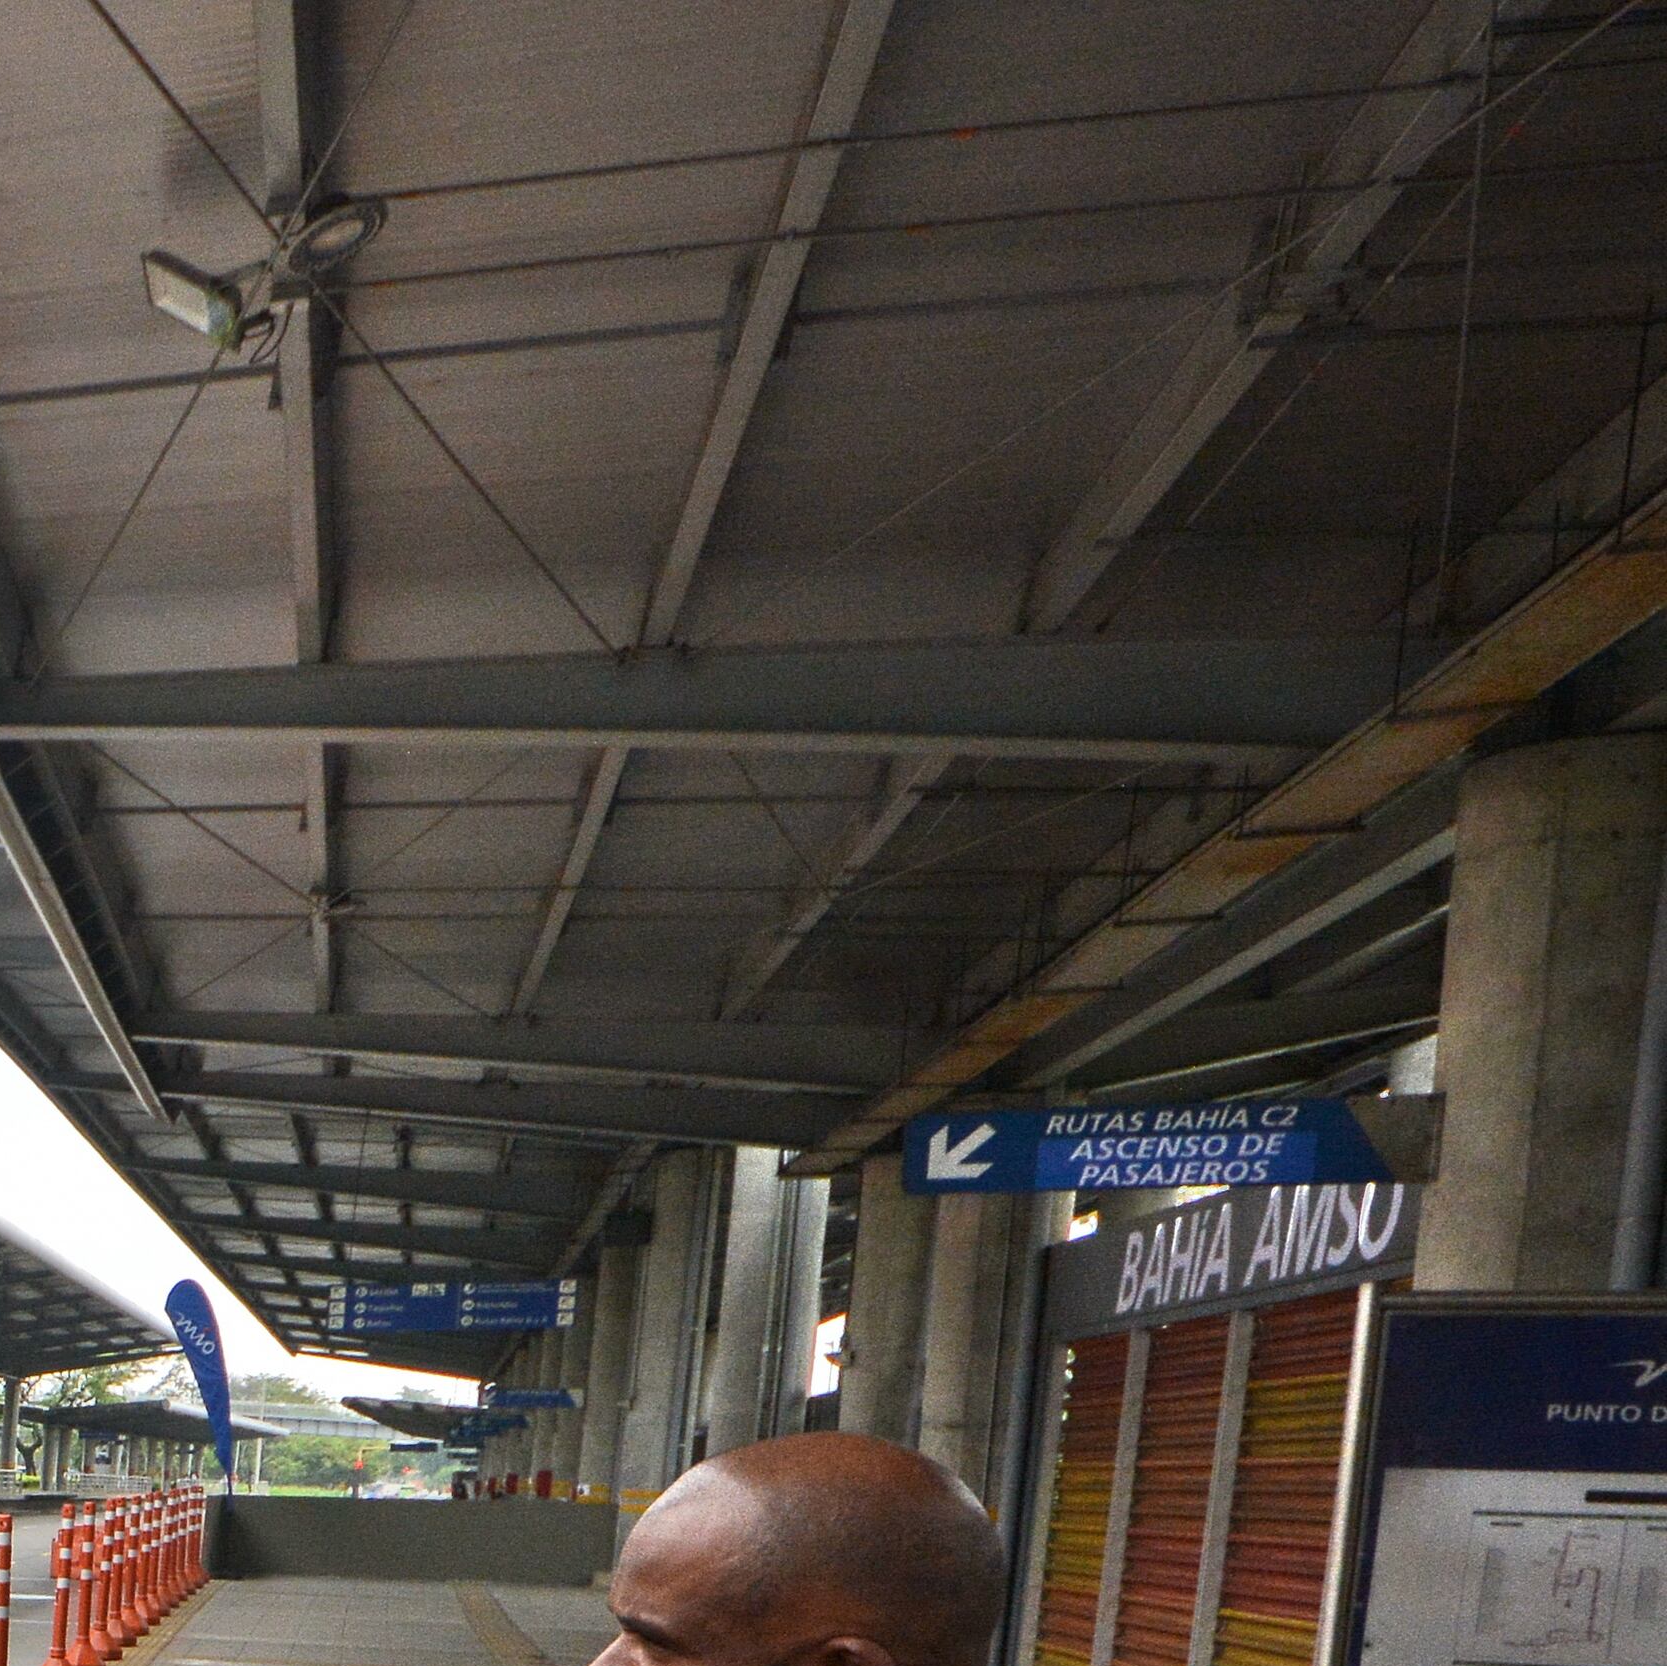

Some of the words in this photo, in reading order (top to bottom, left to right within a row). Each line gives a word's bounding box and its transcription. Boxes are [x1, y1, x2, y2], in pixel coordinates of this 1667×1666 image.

[1046, 1111, 1145, 1135] RUTAS
[1153, 1104, 1249, 1131] BAHÍA
[1261, 1106, 1299, 1128] C2
[1069, 1134, 1228, 1162] ASCENSO
[1238, 1133, 1286, 1156] DE
[1078, 1160, 1270, 1187] PASAJEROS
[1547, 1403, 1642, 1423] PUNTO
